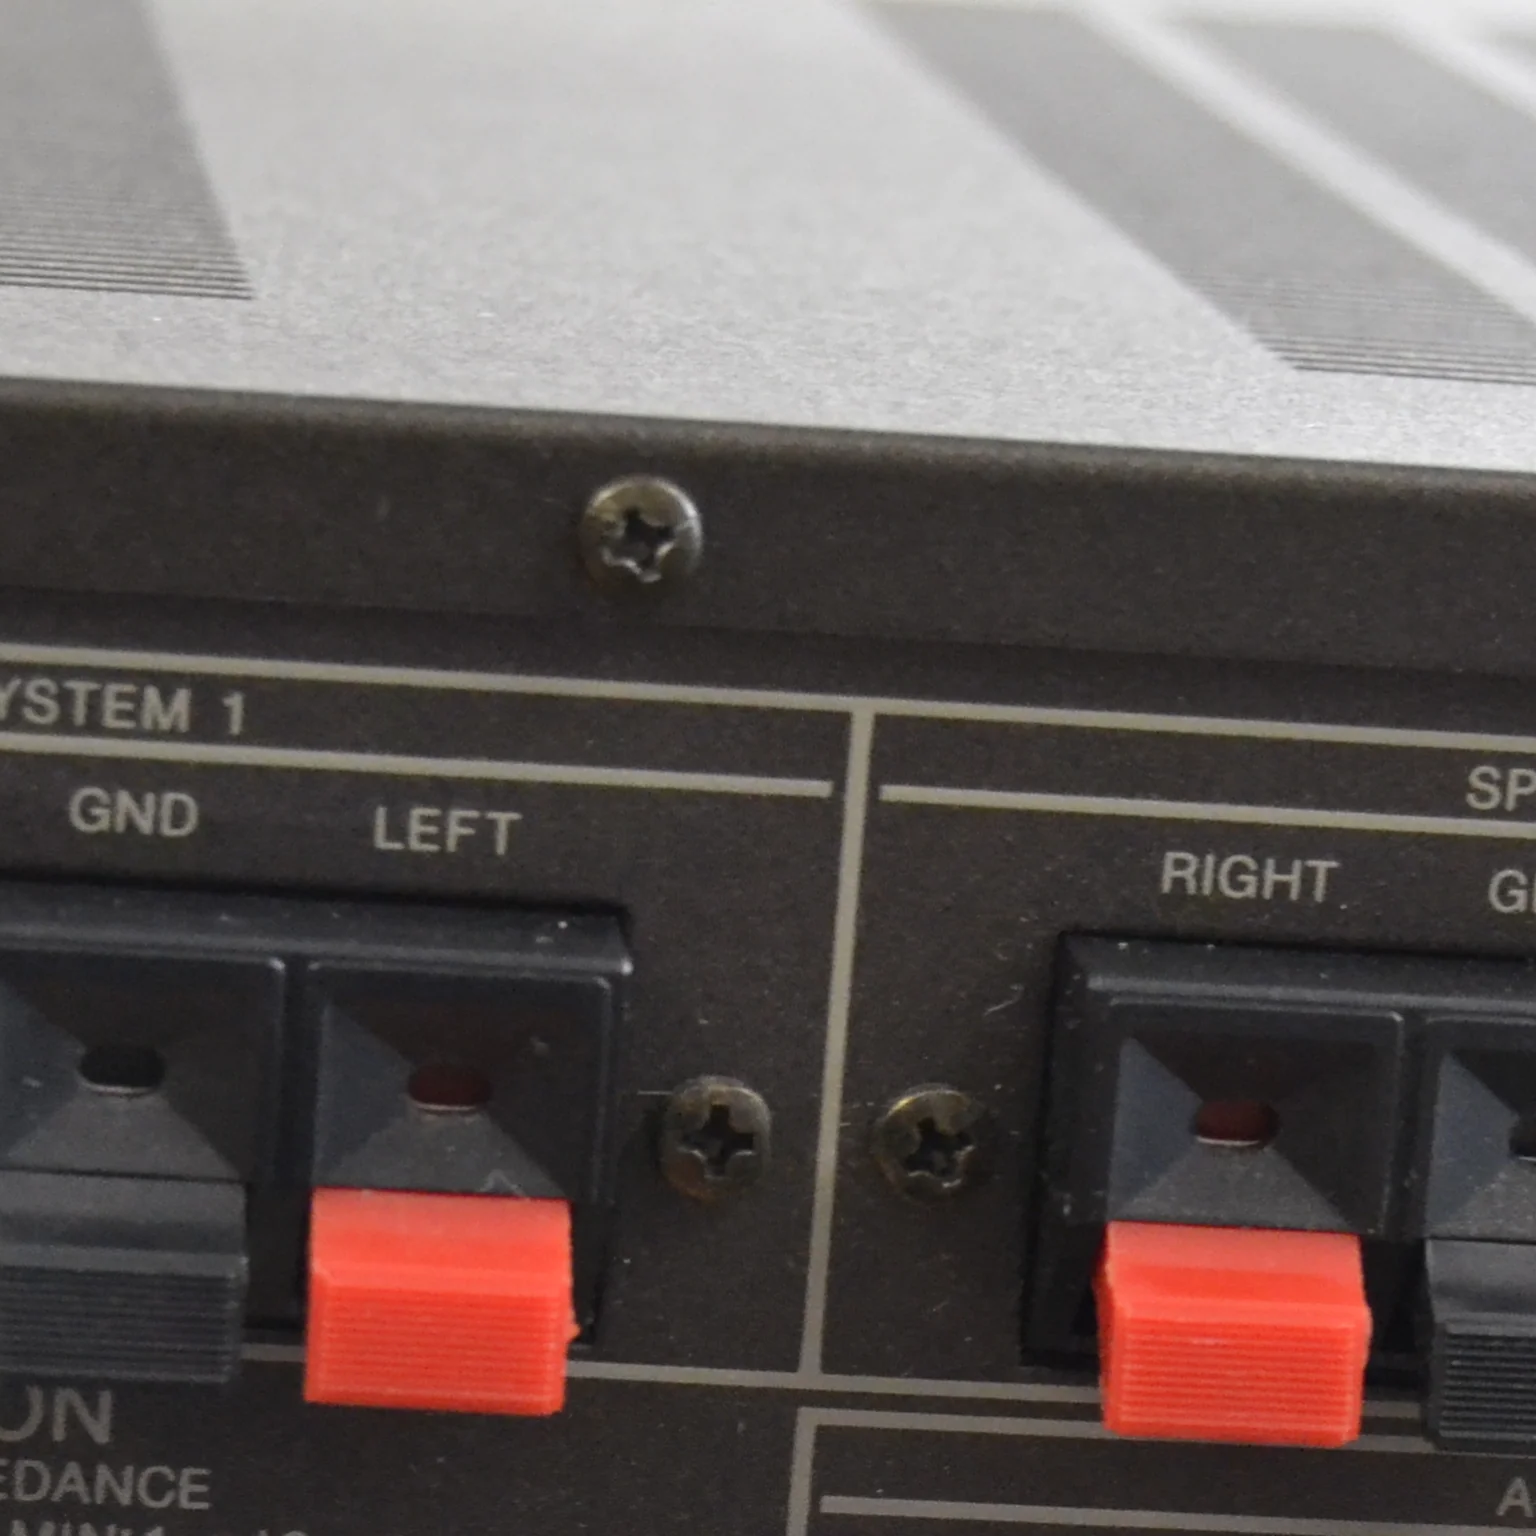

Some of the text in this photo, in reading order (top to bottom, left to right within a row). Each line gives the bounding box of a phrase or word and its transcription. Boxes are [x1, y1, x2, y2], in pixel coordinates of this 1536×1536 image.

[224, 694, 245, 735] 1
[69, 788, 198, 837] GND
[374, 809, 520, 857] LEFT
[1162, 852, 1337, 903] RIGHT
